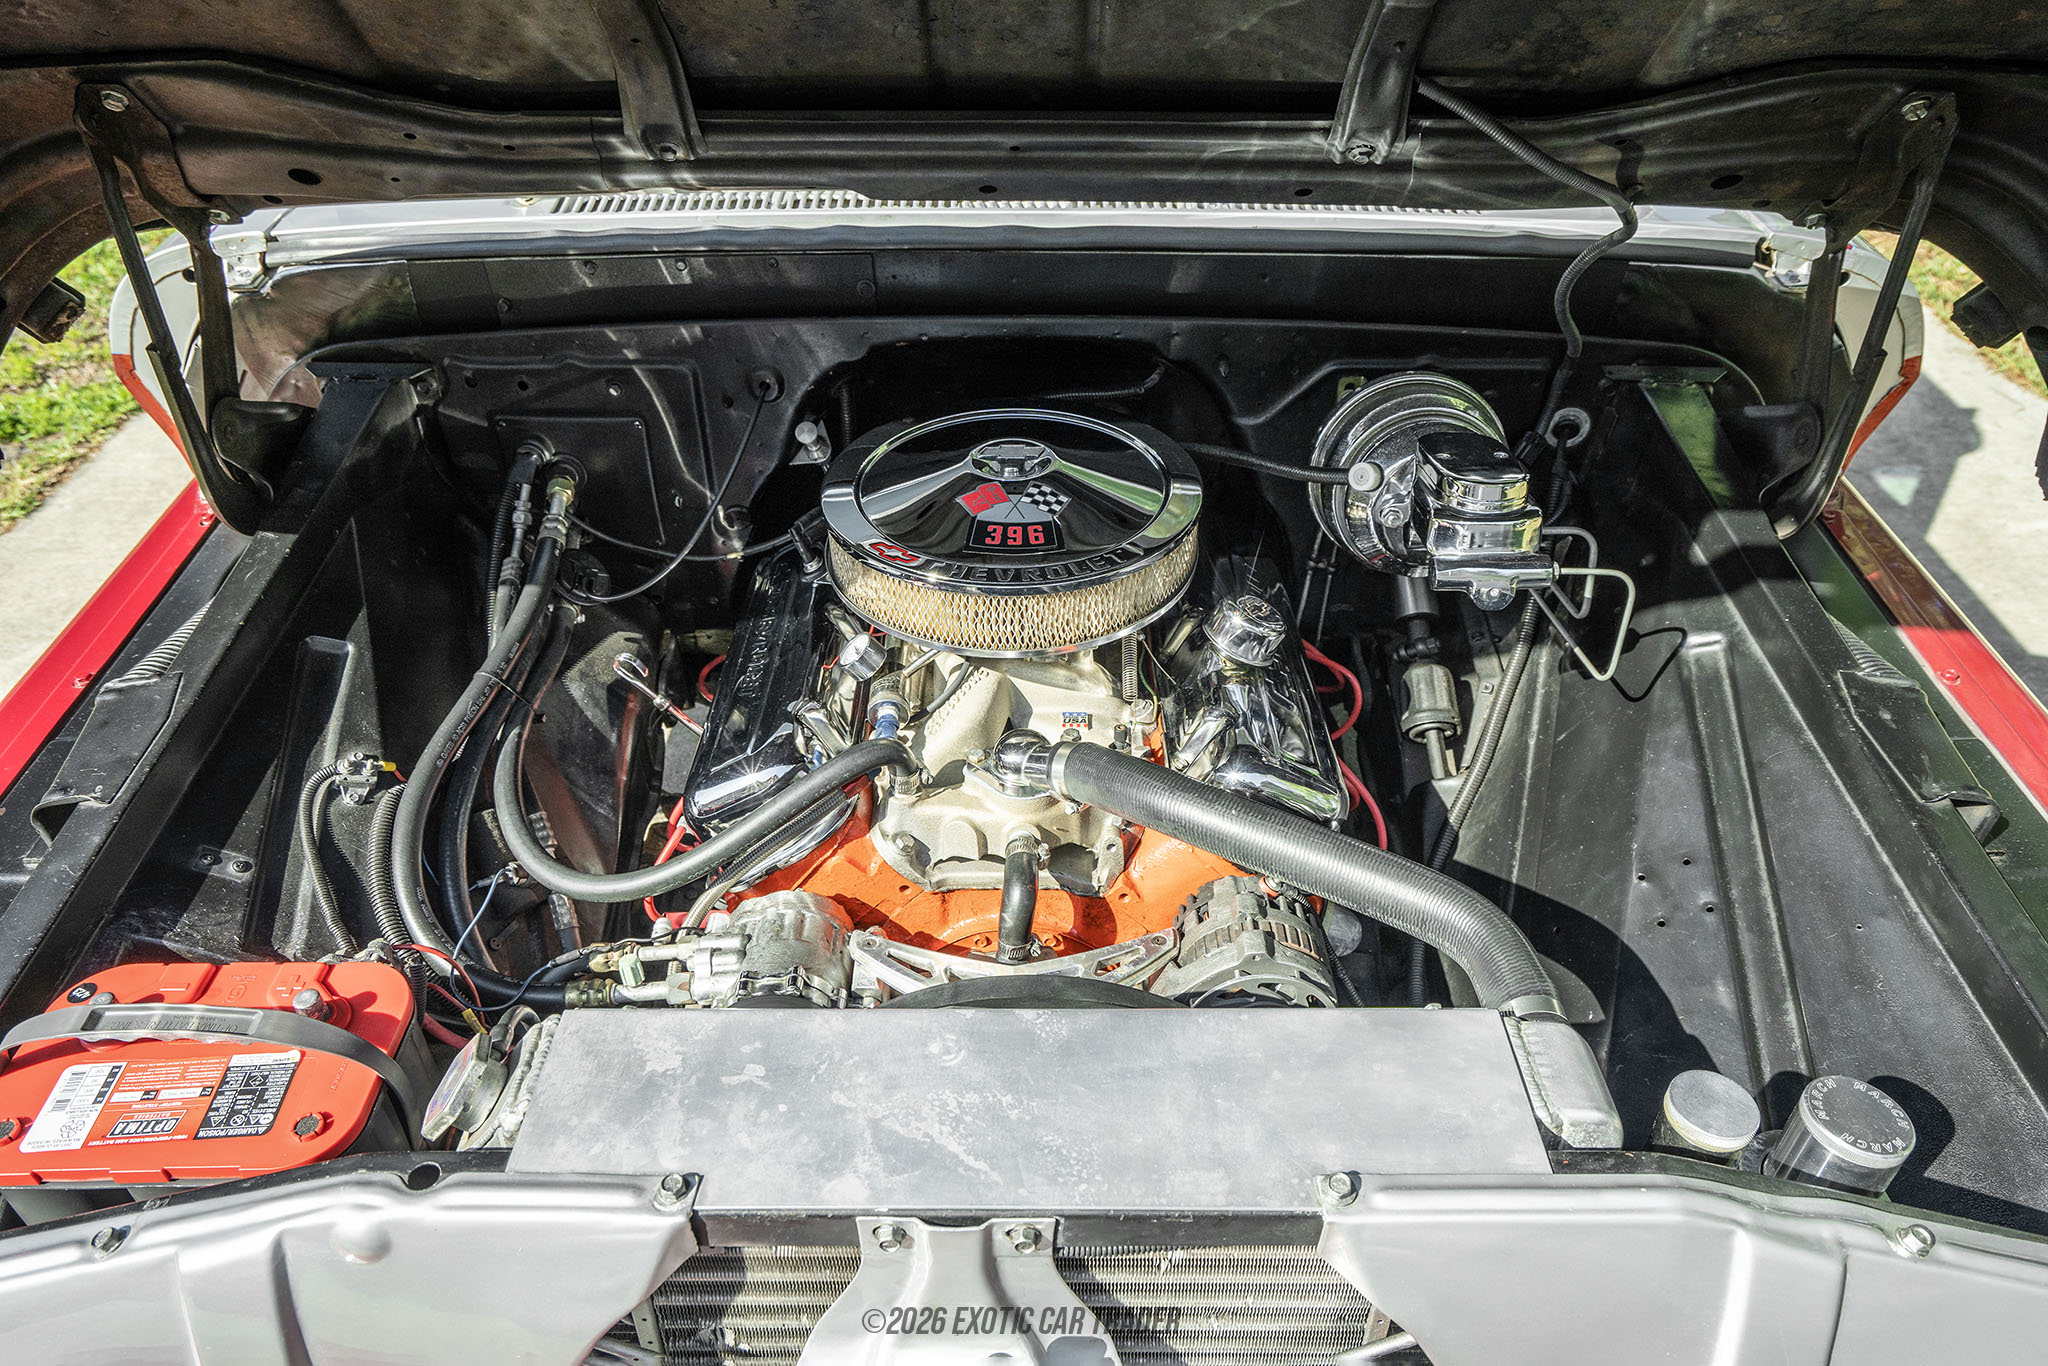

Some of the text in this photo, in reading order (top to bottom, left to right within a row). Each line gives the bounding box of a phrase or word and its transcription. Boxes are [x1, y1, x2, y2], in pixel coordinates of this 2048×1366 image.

[985, 525, 1044, 545] 396
[926, 549, 1129, 583] CHEVROLET
[1811, 1078, 1836, 1121] MARCH
[1853, 1081, 1911, 1131] MARCH
[113, 1119, 178, 1134] OPTIMA
[197, 1127, 257, 1137] DANGER/POISON
[1840, 1132, 1906, 1154] MARCH
